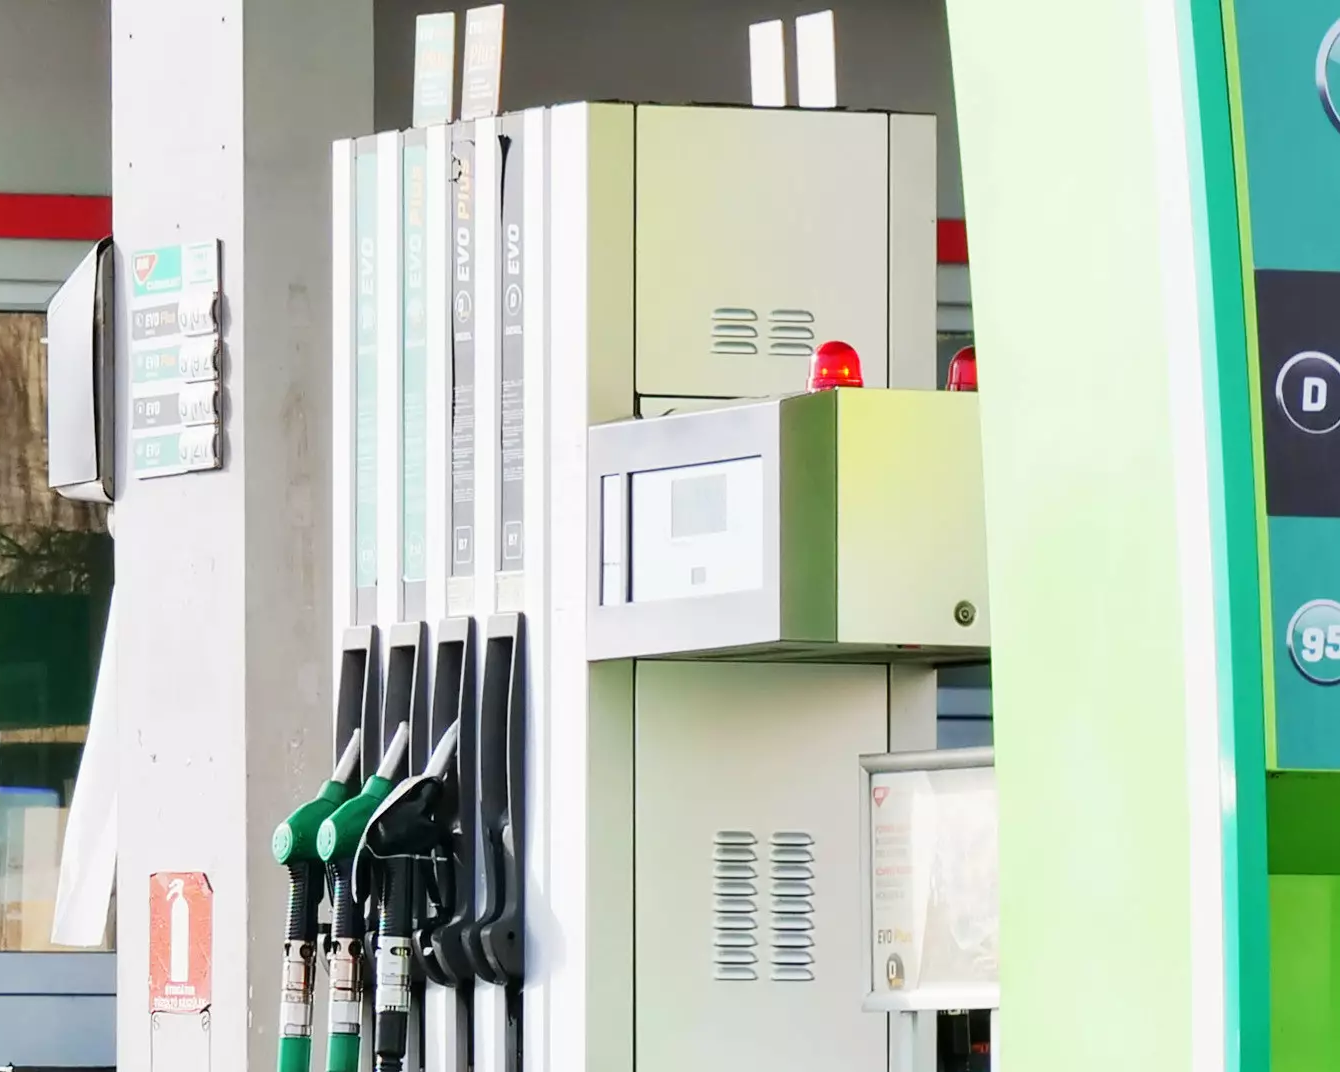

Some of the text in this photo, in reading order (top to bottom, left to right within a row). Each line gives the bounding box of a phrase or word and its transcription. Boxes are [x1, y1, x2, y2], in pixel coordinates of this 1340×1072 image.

[457, 226, 470, 282] EVO
[507, 223, 520, 275] EVO
[1302, 376, 1328, 412] D
[1301, 624, 1340, 663] 95
[877, 928, 892, 945] EVO
